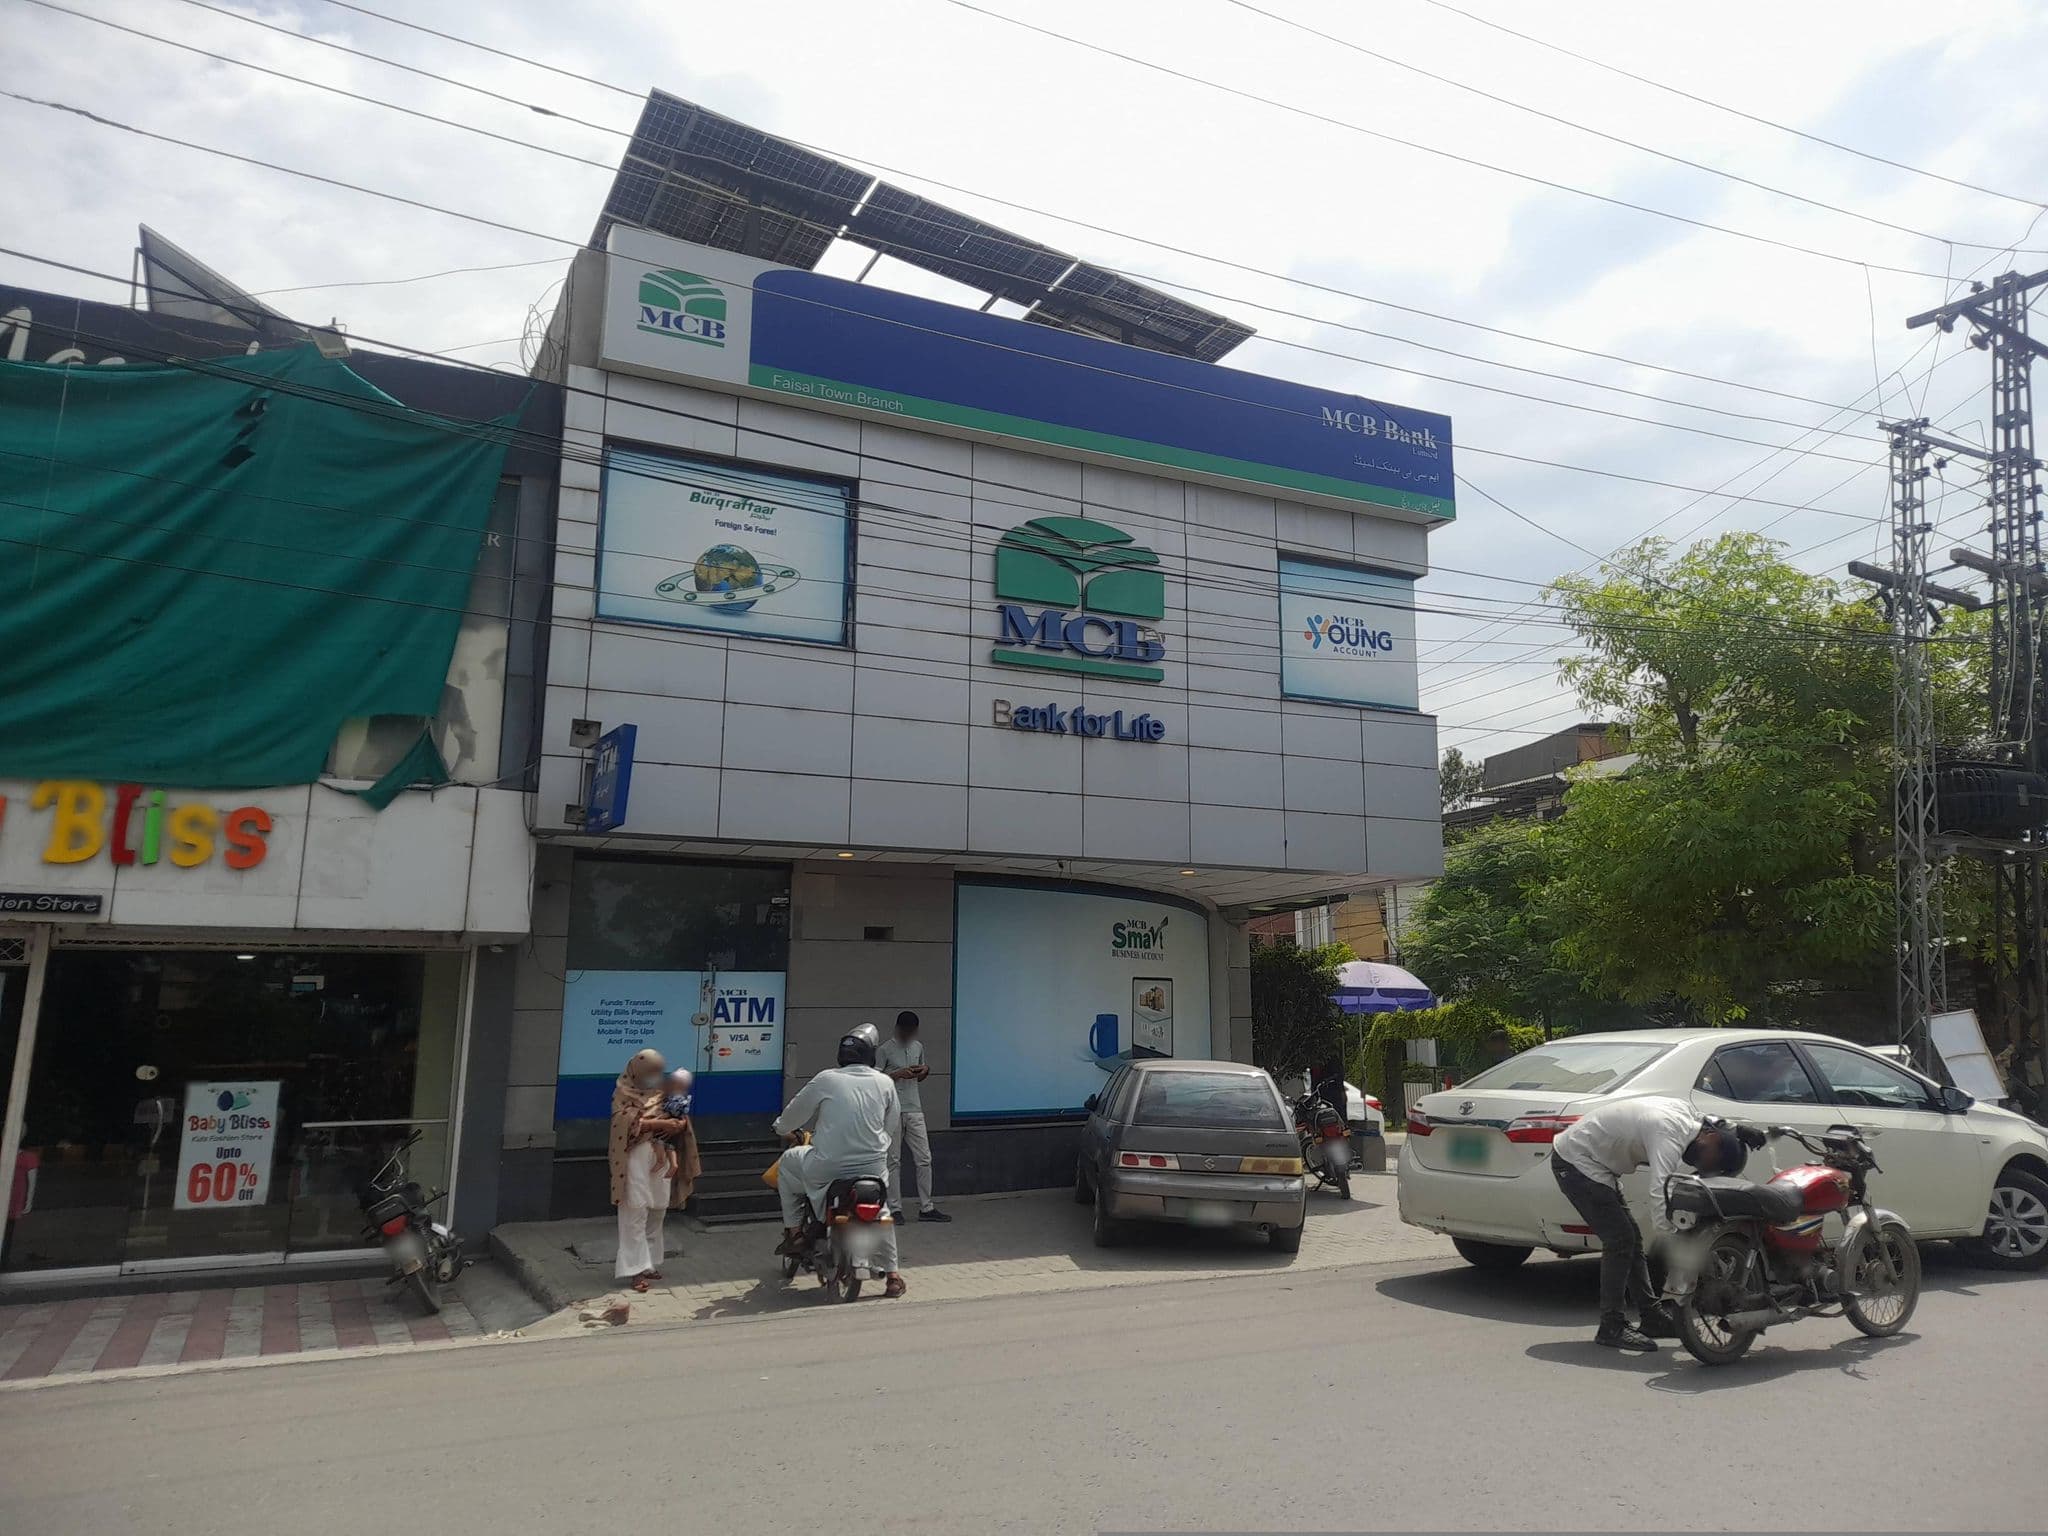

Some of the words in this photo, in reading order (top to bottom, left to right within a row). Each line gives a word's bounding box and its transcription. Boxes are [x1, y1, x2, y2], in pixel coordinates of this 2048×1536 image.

[639, 306, 725, 340] MCB
[773, 374, 814, 394] Faisal
[819, 383, 854, 402] Town
[857, 392, 904, 412] Branch
[1321, 406, 1376, 436] MCB
[1384, 420, 1437, 449] Bank
[714, 518, 742, 531] Foreign
[1332, 615, 1364, 627] MCB
[993, 604, 1165, 662] MCB
[1333, 646, 1378, 658] ACCOUNT
[992, 698, 1068, 732] Bank
[1070, 706, 1111, 736] for
[1114, 710, 1166, 741] Life
[29, 782, 273, 870] Bliss
[36, 895, 98, 912] Store
[1127, 919, 1147, 929] MCB
[1112, 949, 1140, 959] BUSINESS
[591, 1008, 613, 1017] Utility
[613, 1008, 630, 1016] Bills
[631, 1008, 664, 1017] Payment
[714, 997, 775, 1023] ATM
[624, 1027, 639, 1036] Top
[729, 1034, 750, 1042] VISA
[188, 1115, 226, 1134] Baby
[229, 1114, 267, 1130] Bliss
[216, 1146, 242, 1159] Upto
[238, 1188, 254, 1202] Off
